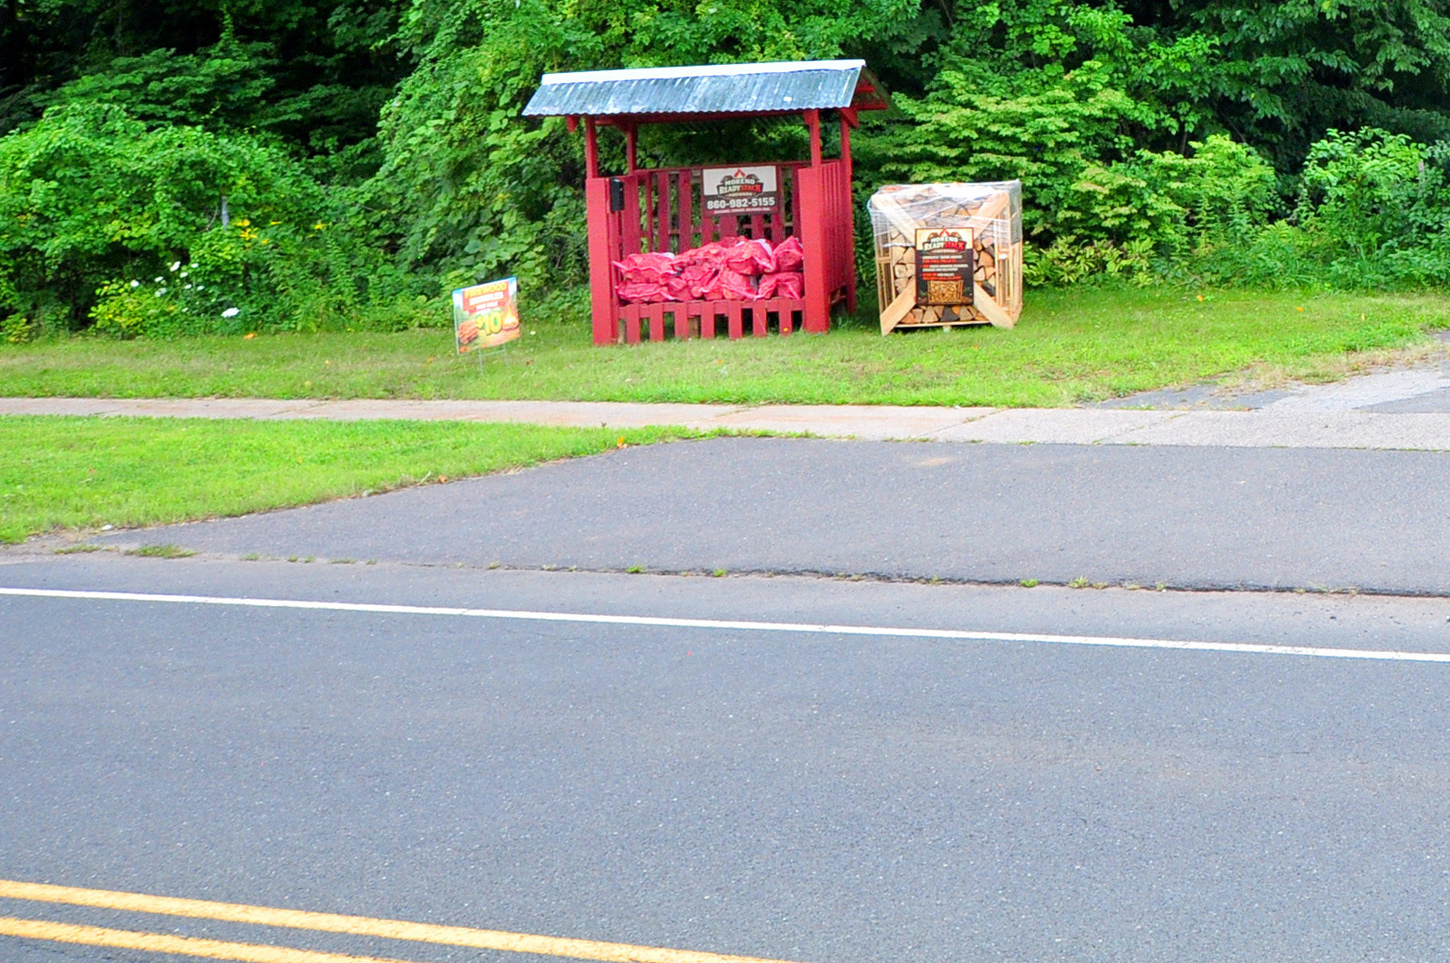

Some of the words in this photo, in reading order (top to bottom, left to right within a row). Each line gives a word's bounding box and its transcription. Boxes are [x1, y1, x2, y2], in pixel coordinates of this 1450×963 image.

[707, 197, 775, 210] 860-982-5155
[464, 282, 507, 299] FIREWOOD
[475, 311, 503, 336] $10
